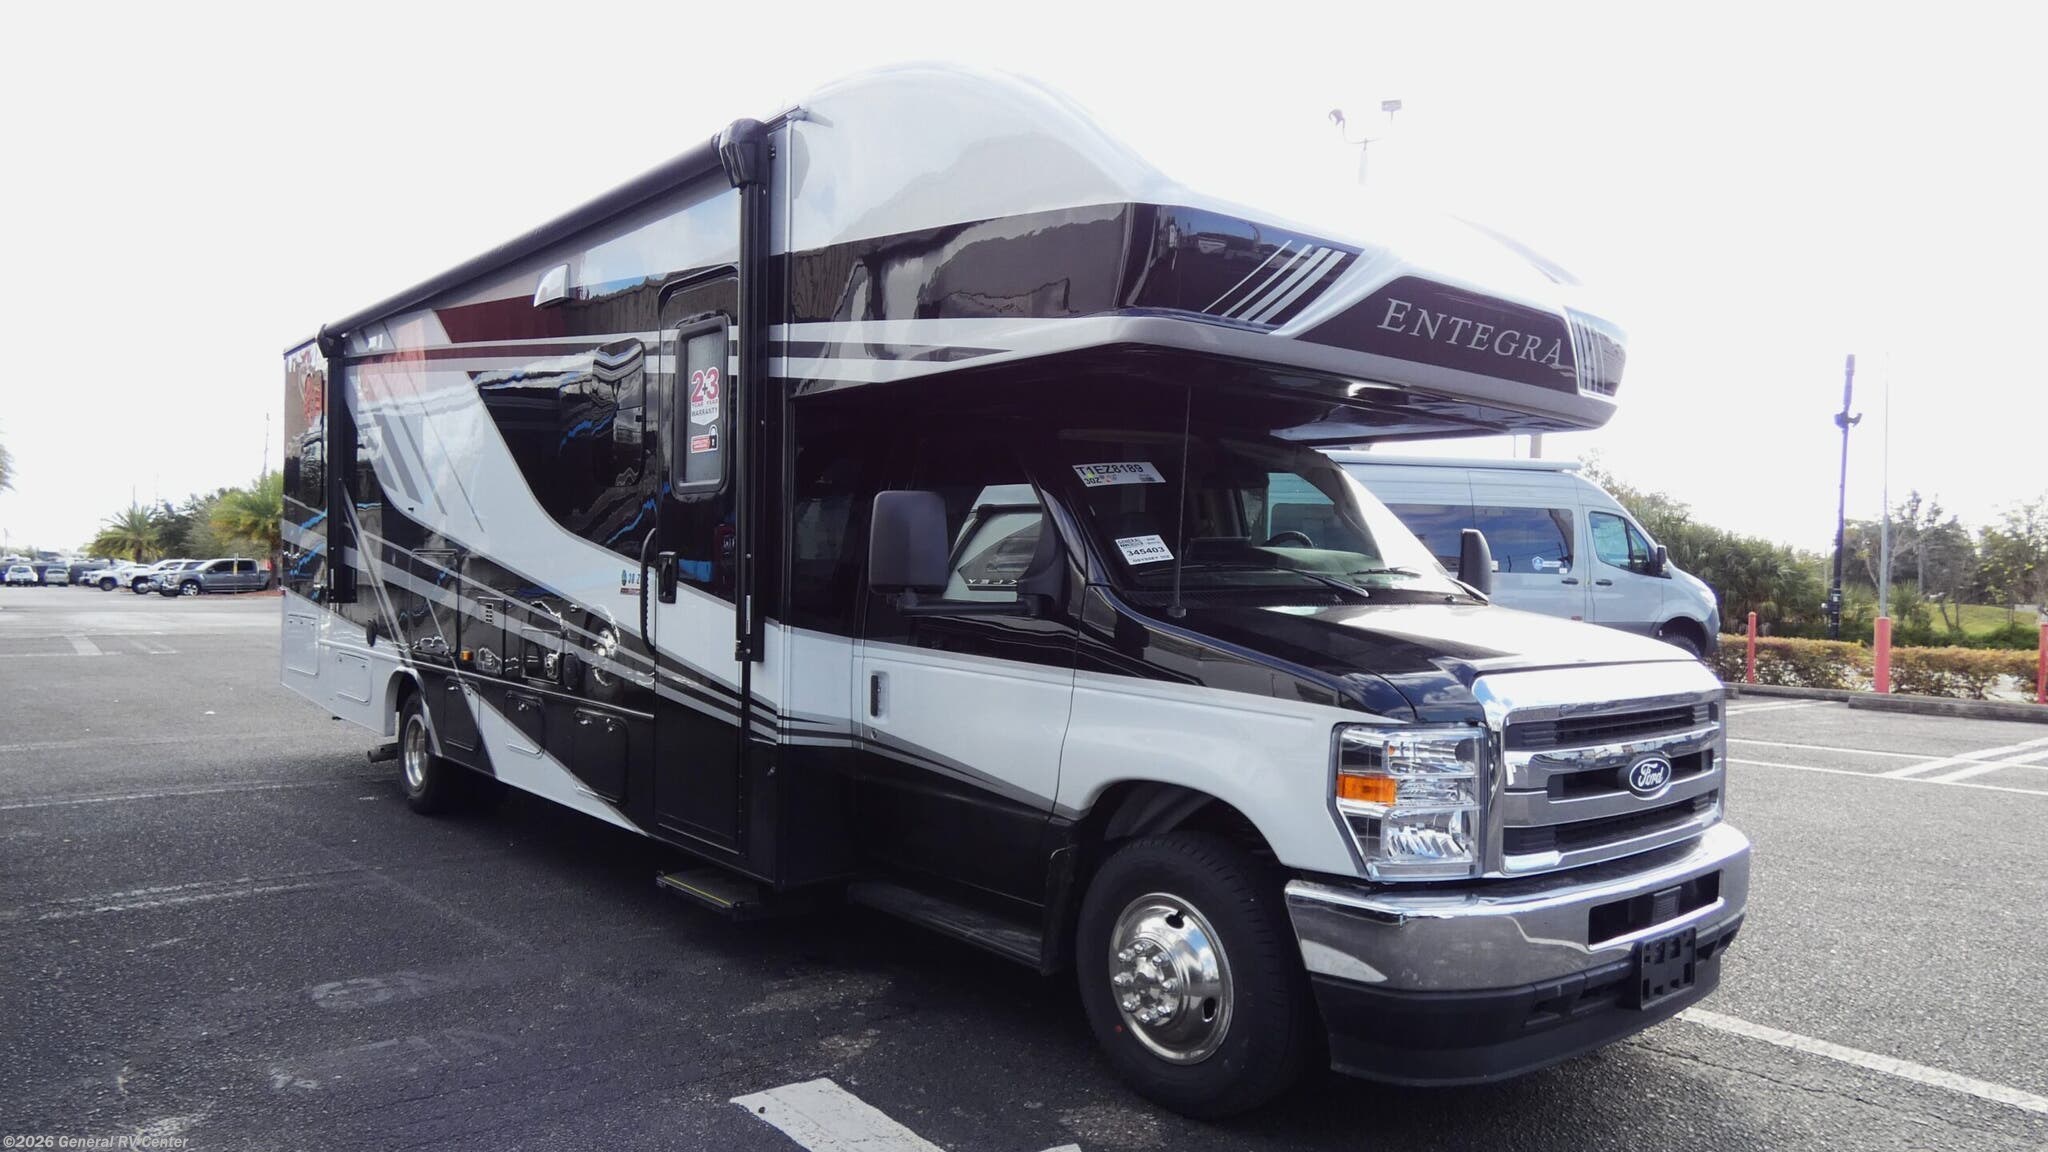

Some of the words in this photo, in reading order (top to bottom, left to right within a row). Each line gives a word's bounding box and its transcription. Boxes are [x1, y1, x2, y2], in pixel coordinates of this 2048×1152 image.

[1377, 298, 1562, 367] ENTEGRA
[691, 407, 718, 417] WARRANTY
[1075, 464, 1144, 476] T1EZ8189
[1126, 546, 1165, 557] 345403
[1637, 763, 1664, 787] Ford
